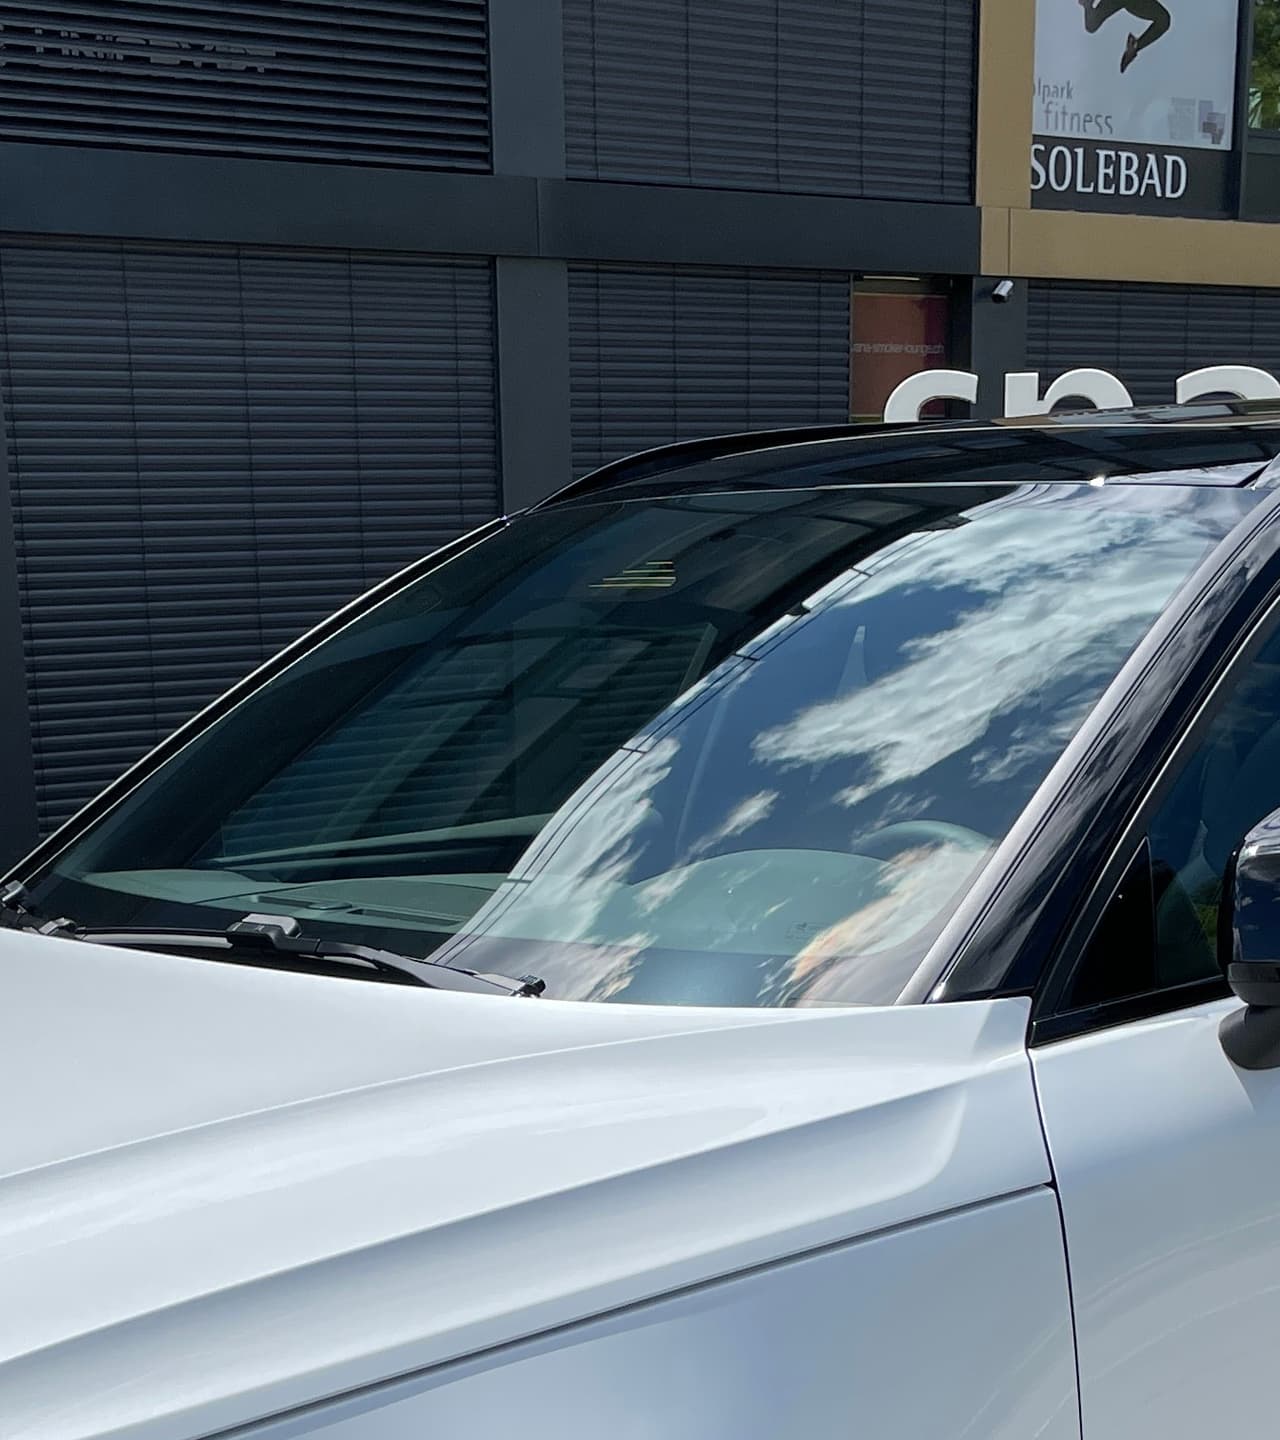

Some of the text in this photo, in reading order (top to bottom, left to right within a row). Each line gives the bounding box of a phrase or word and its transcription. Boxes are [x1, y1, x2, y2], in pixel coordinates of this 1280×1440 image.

[1033, 77, 1073, 104] lpark
[1043, 100, 1114, 136] fitness
[1030, 143, 1188, 199] SOLEBAD
